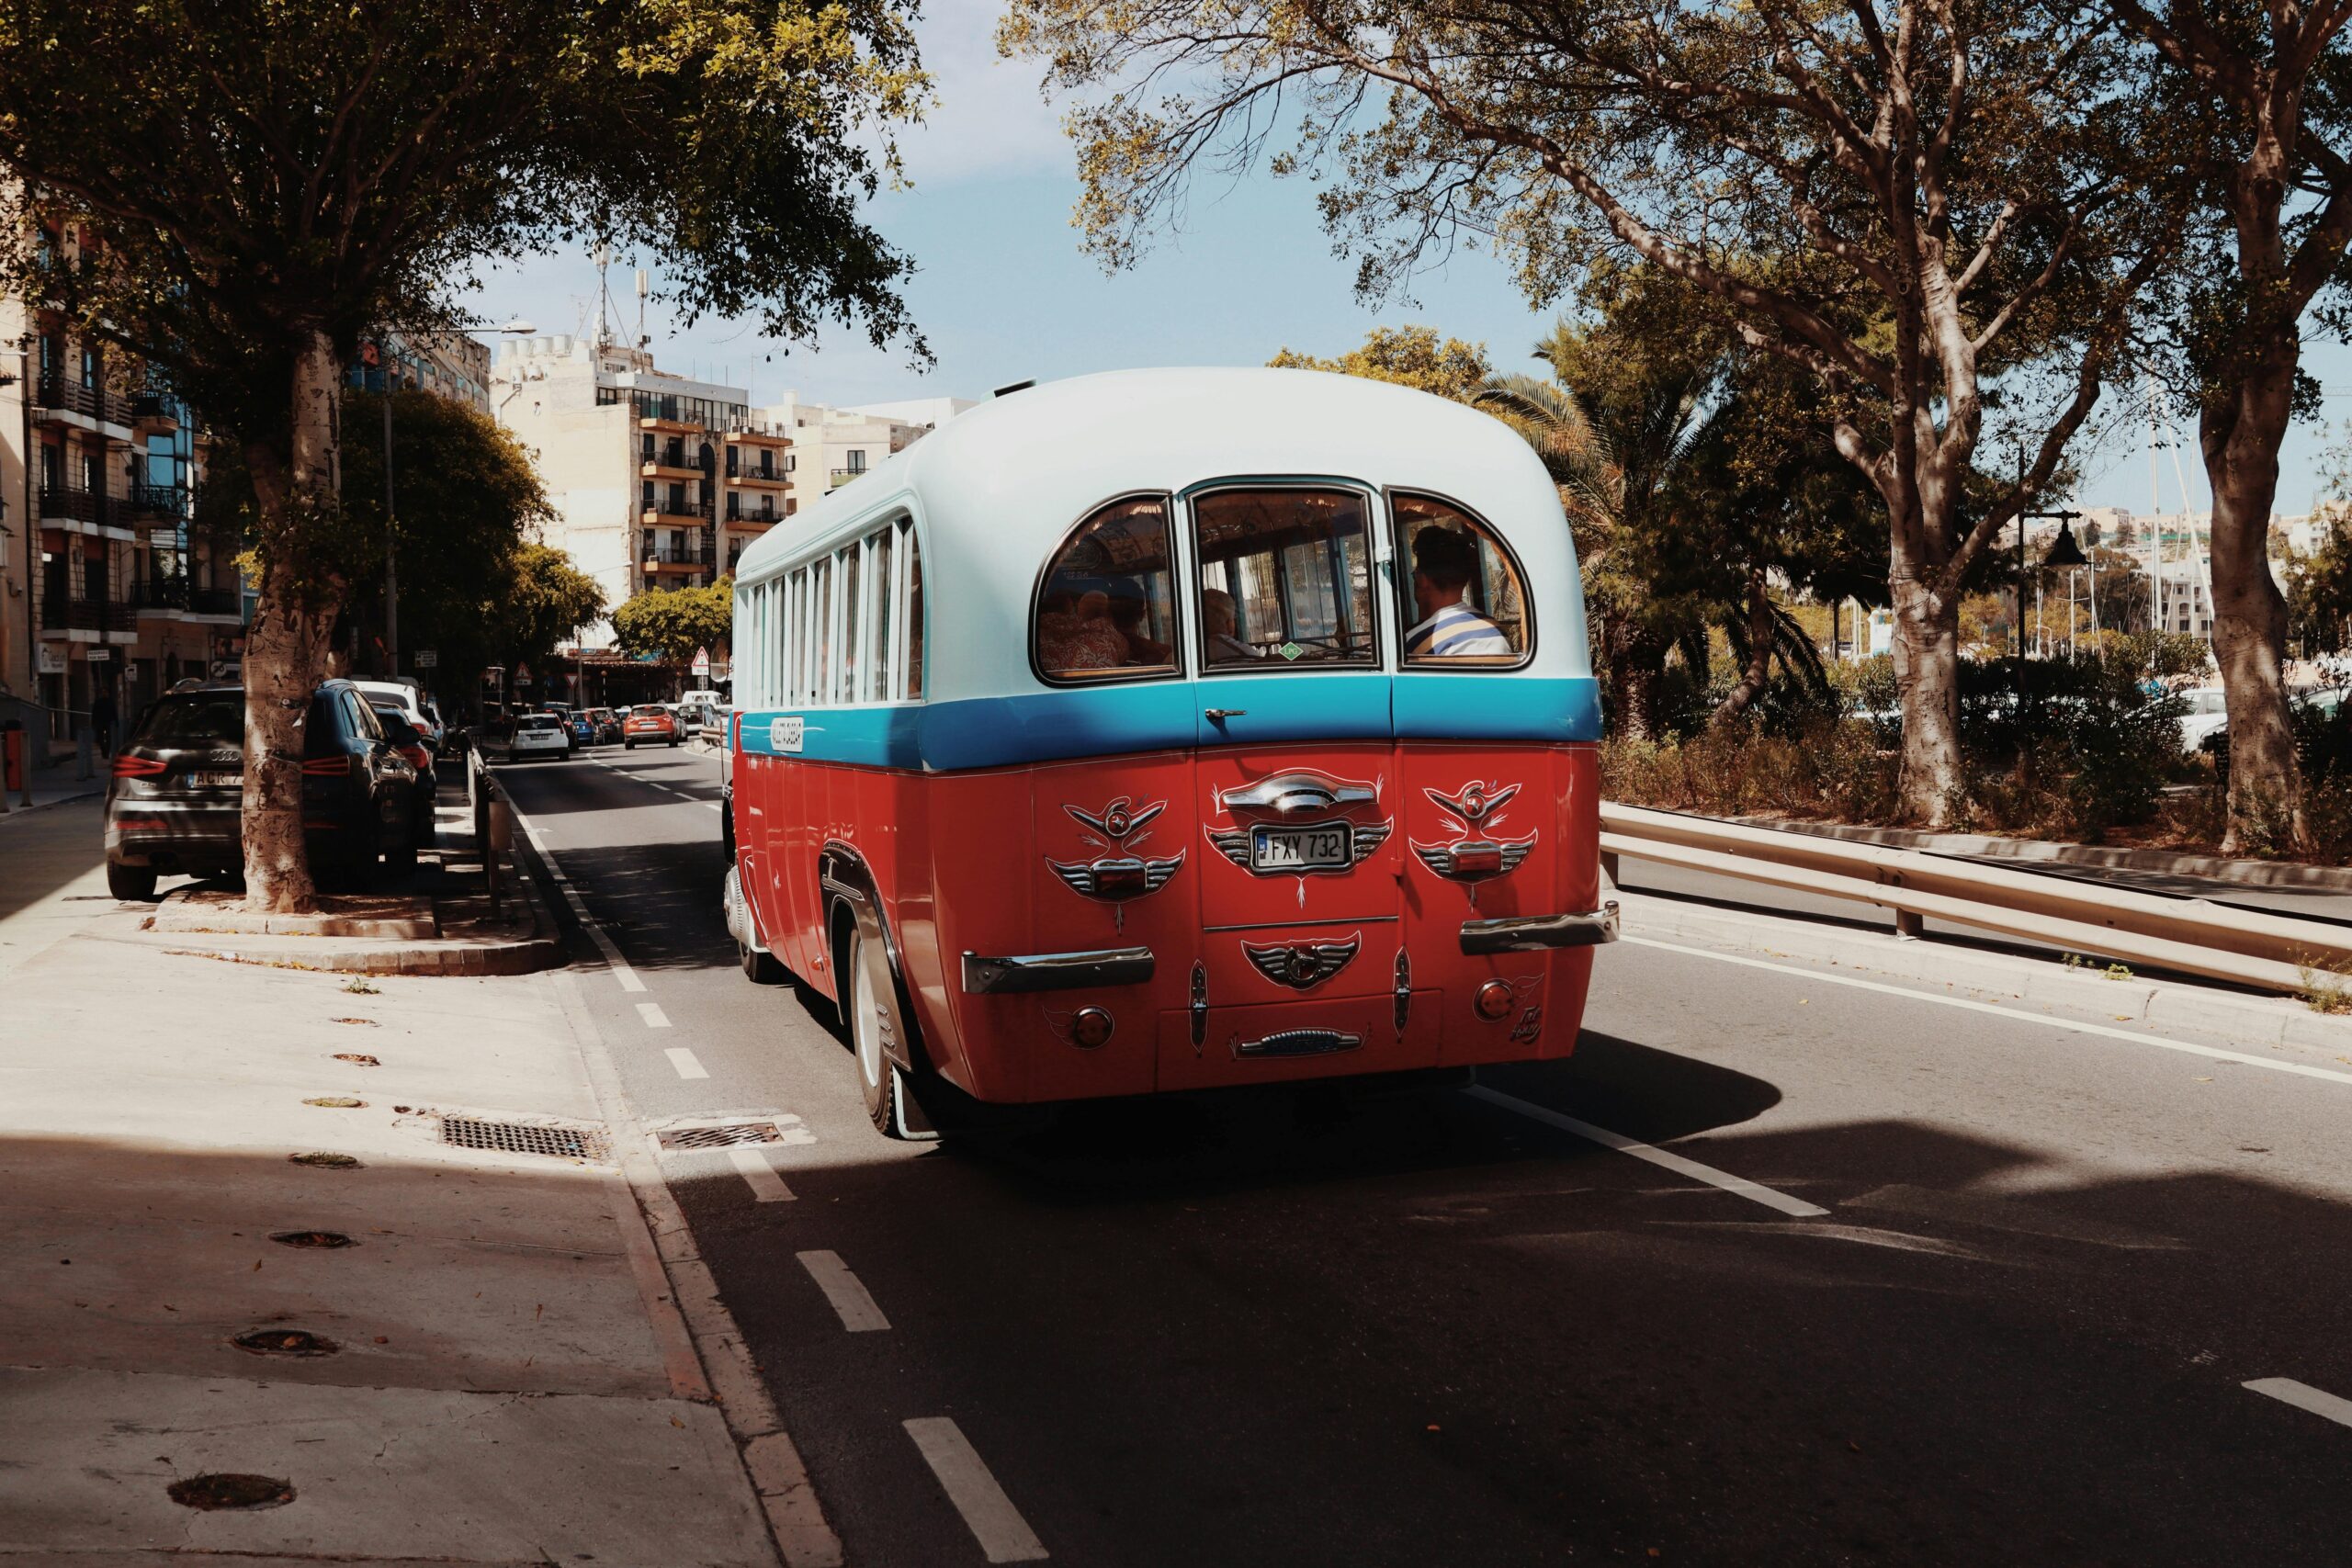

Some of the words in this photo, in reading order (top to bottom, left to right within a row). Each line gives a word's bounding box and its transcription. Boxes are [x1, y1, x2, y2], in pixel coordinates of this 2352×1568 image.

[197, 772, 226, 784] ACR
[232, 772, 244, 784] 7
[1272, 835, 1301, 861] FXY
[1308, 833, 1339, 858] 732
